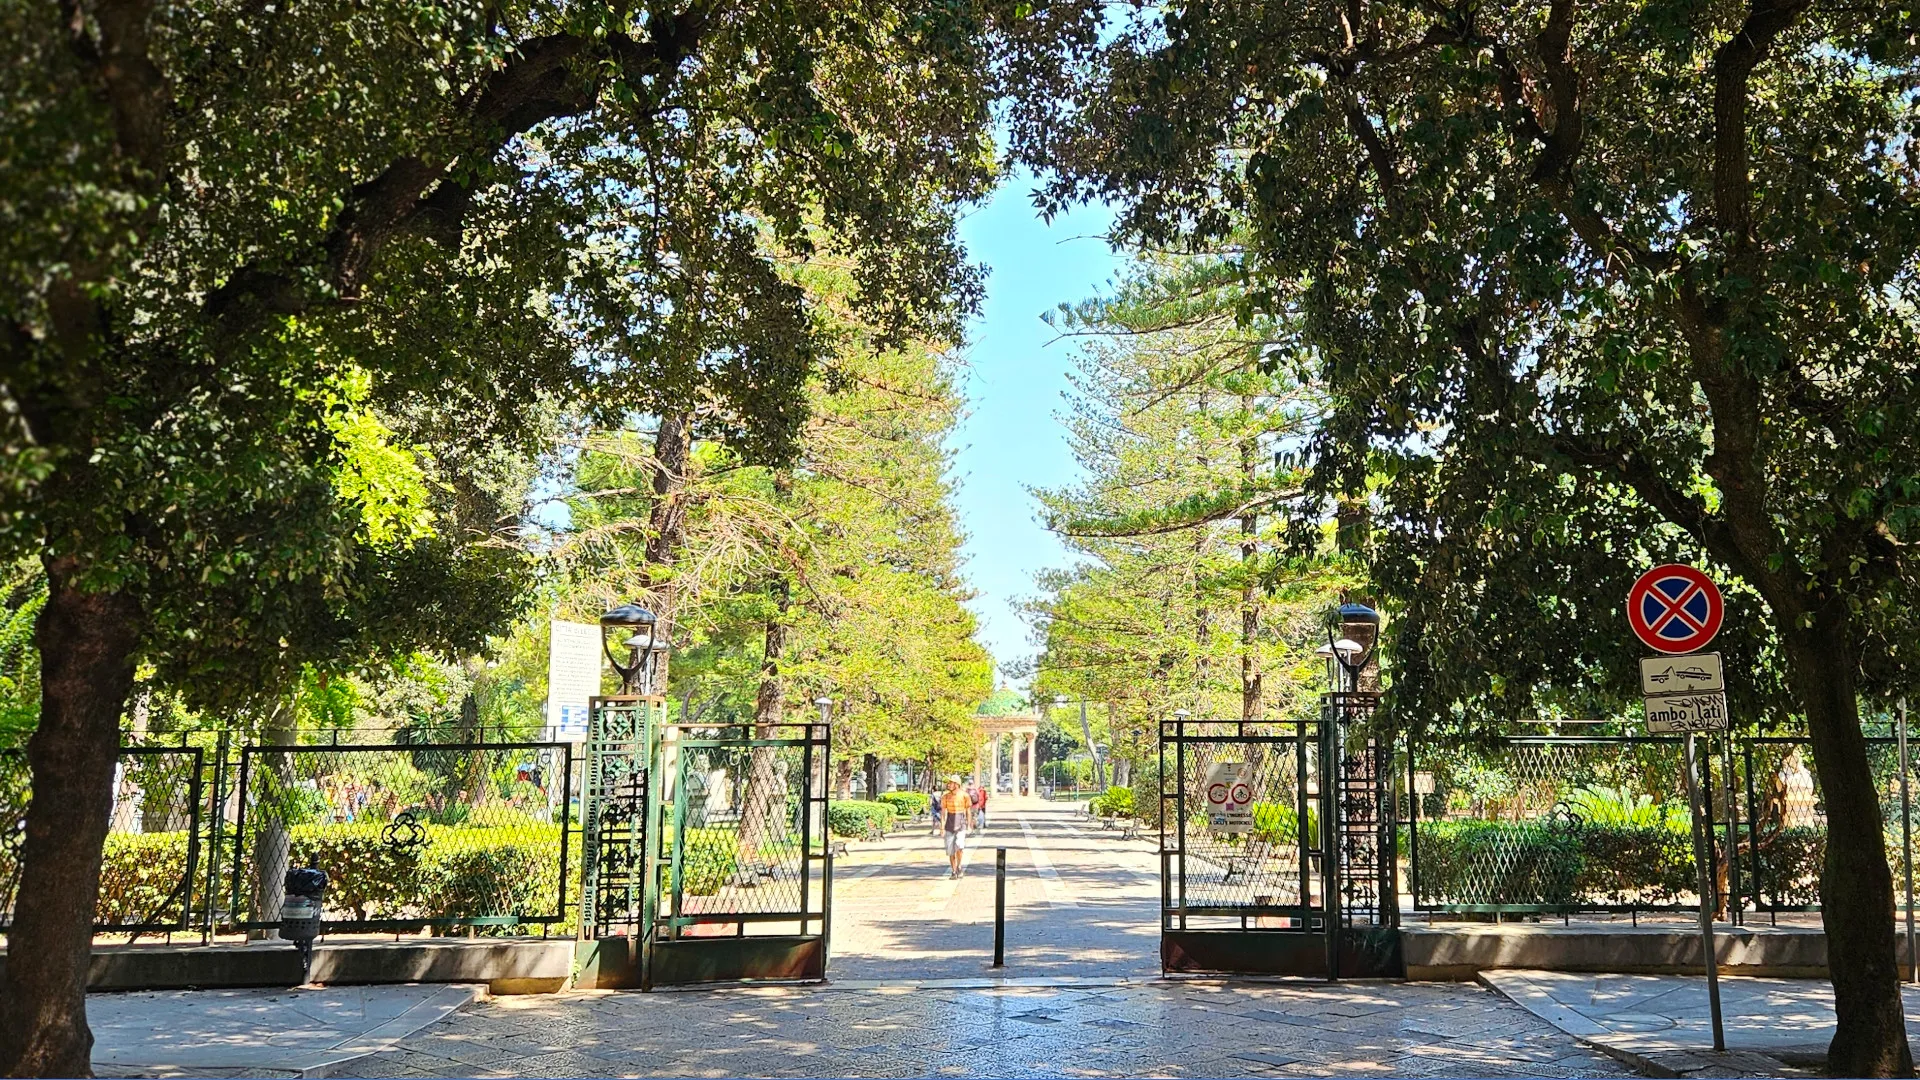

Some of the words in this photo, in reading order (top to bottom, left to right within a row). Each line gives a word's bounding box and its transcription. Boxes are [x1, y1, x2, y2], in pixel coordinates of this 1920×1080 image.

[1650, 706, 1687, 722] ambo
[1691, 710, 1694, 719] i
[1698, 704, 1722, 720] lati
